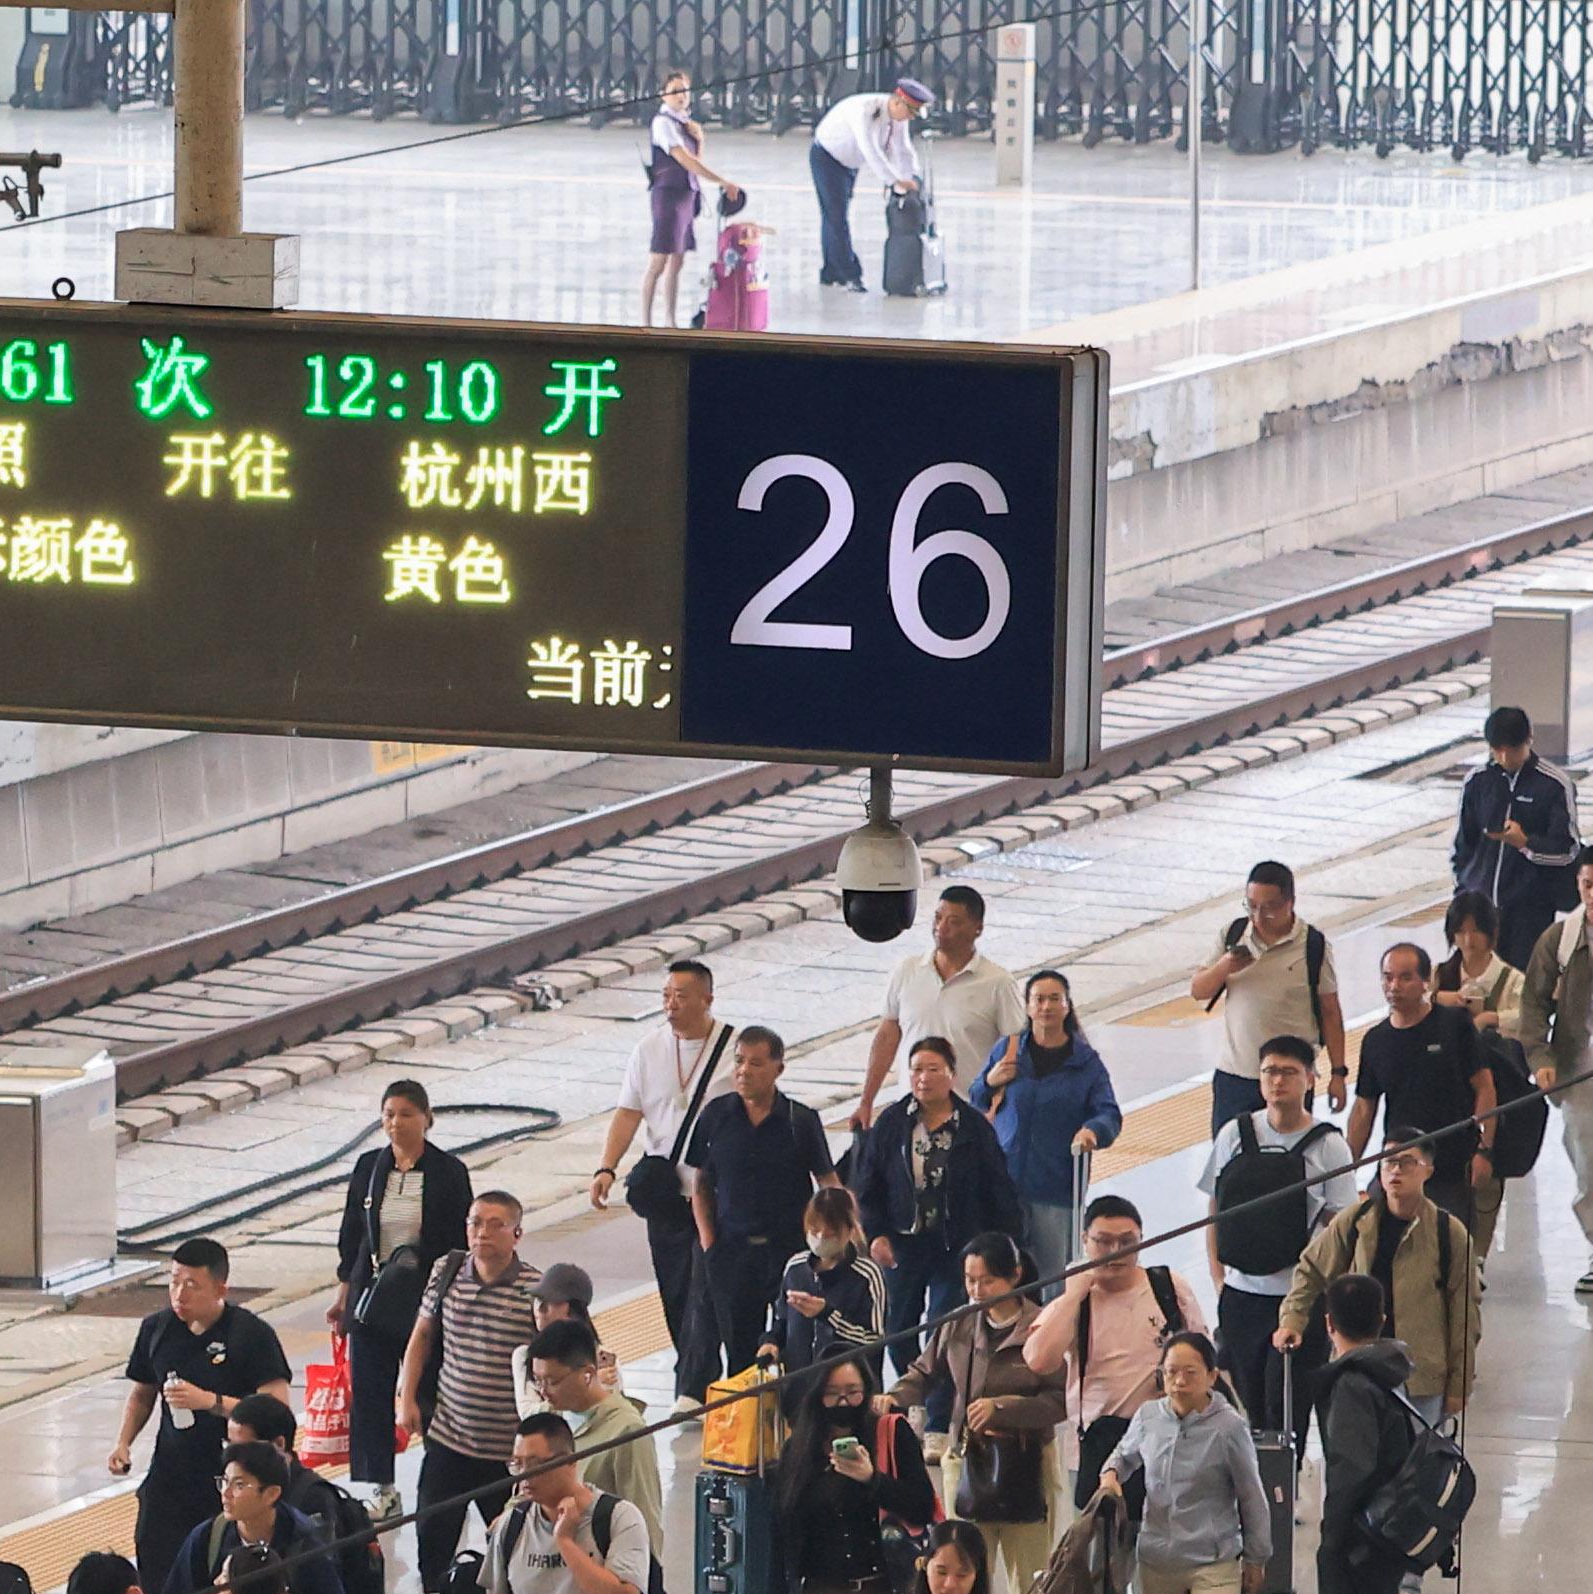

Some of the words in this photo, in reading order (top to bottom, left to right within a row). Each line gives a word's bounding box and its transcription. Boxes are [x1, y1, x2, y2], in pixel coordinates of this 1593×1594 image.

[135, 336, 215, 420] 次
[305, 353, 499, 424] 12:10
[544, 358, 623, 438] 开
[163, 432, 293, 502] 开往
[399, 440, 593, 516] 杭州西
[383, 535, 513, 605] 黄色
[730, 454, 1011, 660] 26
